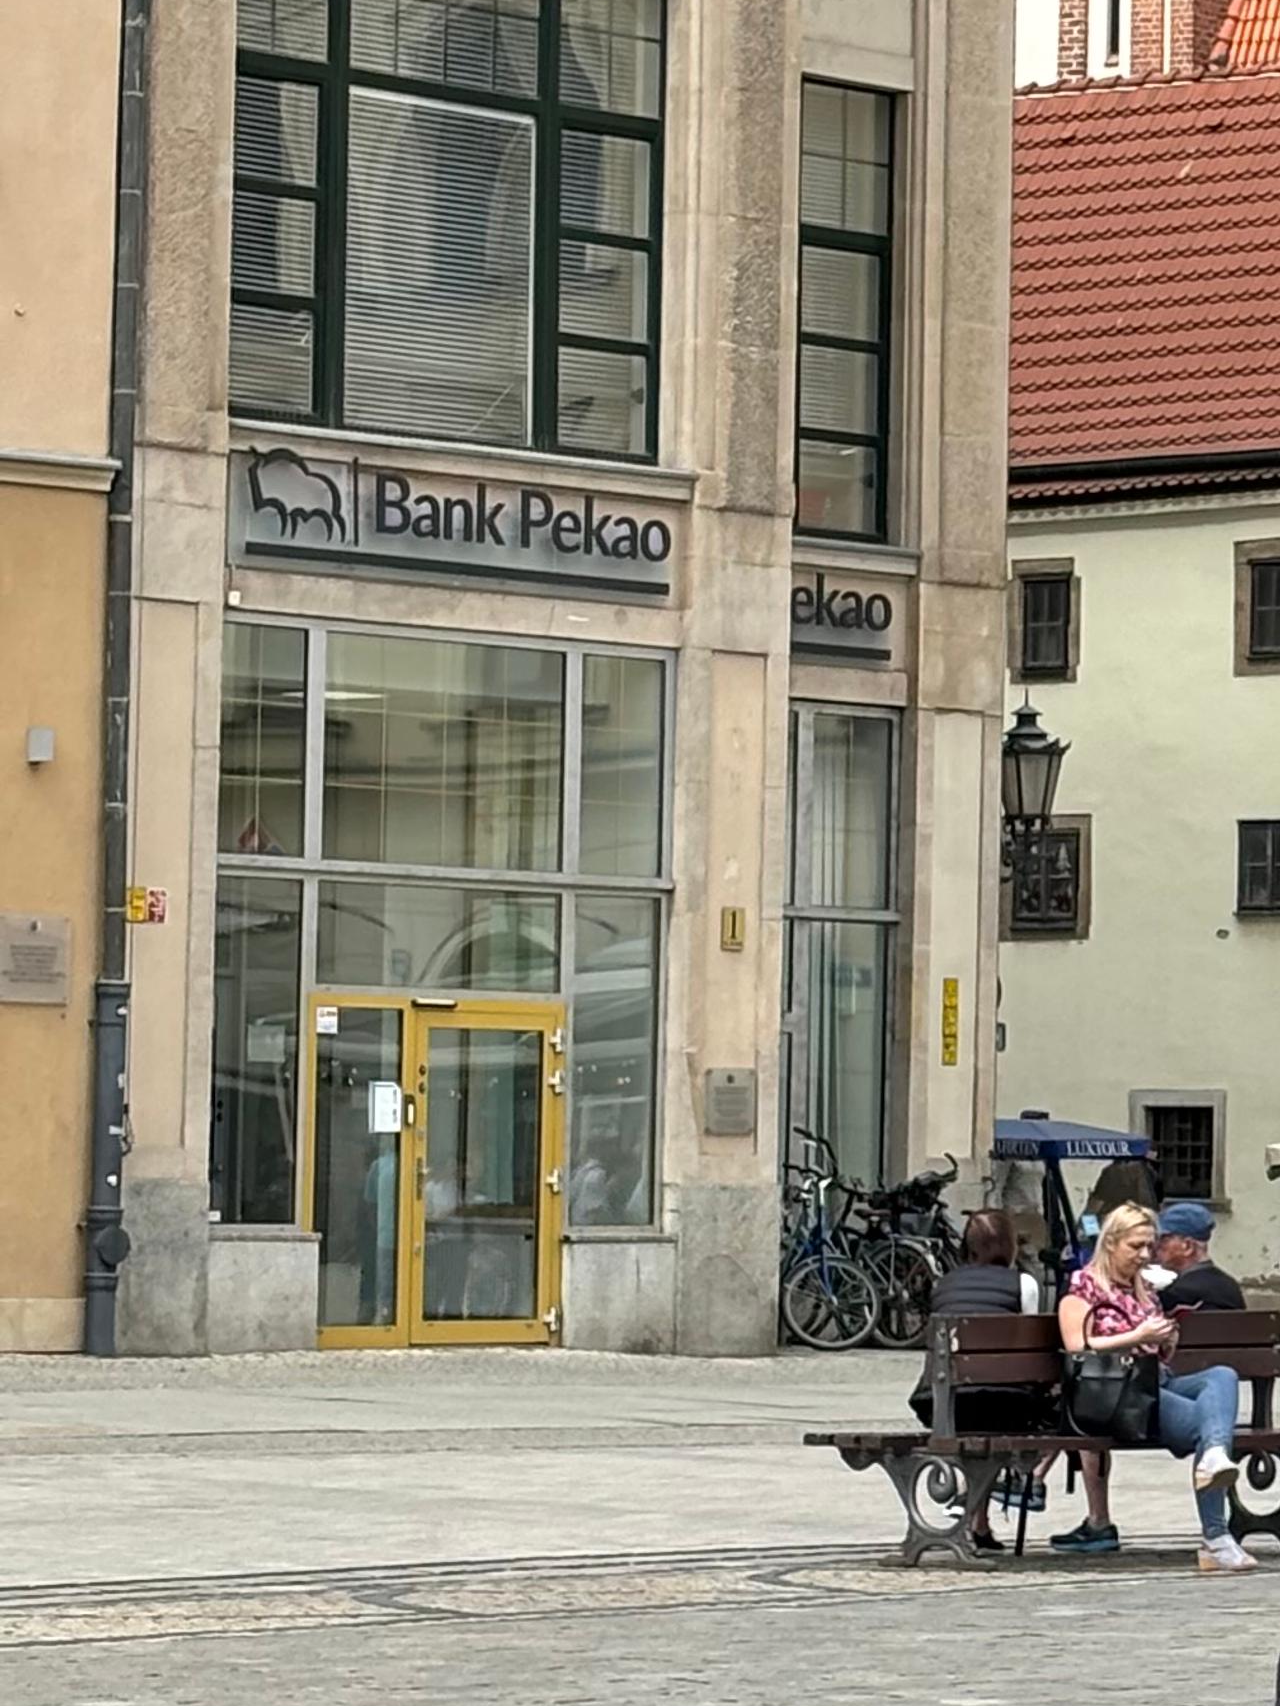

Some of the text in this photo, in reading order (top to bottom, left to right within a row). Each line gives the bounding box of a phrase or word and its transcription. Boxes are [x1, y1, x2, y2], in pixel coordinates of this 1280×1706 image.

[375, 473, 671, 564] Bank Pekao
[792, 572, 892, 632] ekao
[1066, 1141, 1131, 1157] LUXTOUR
